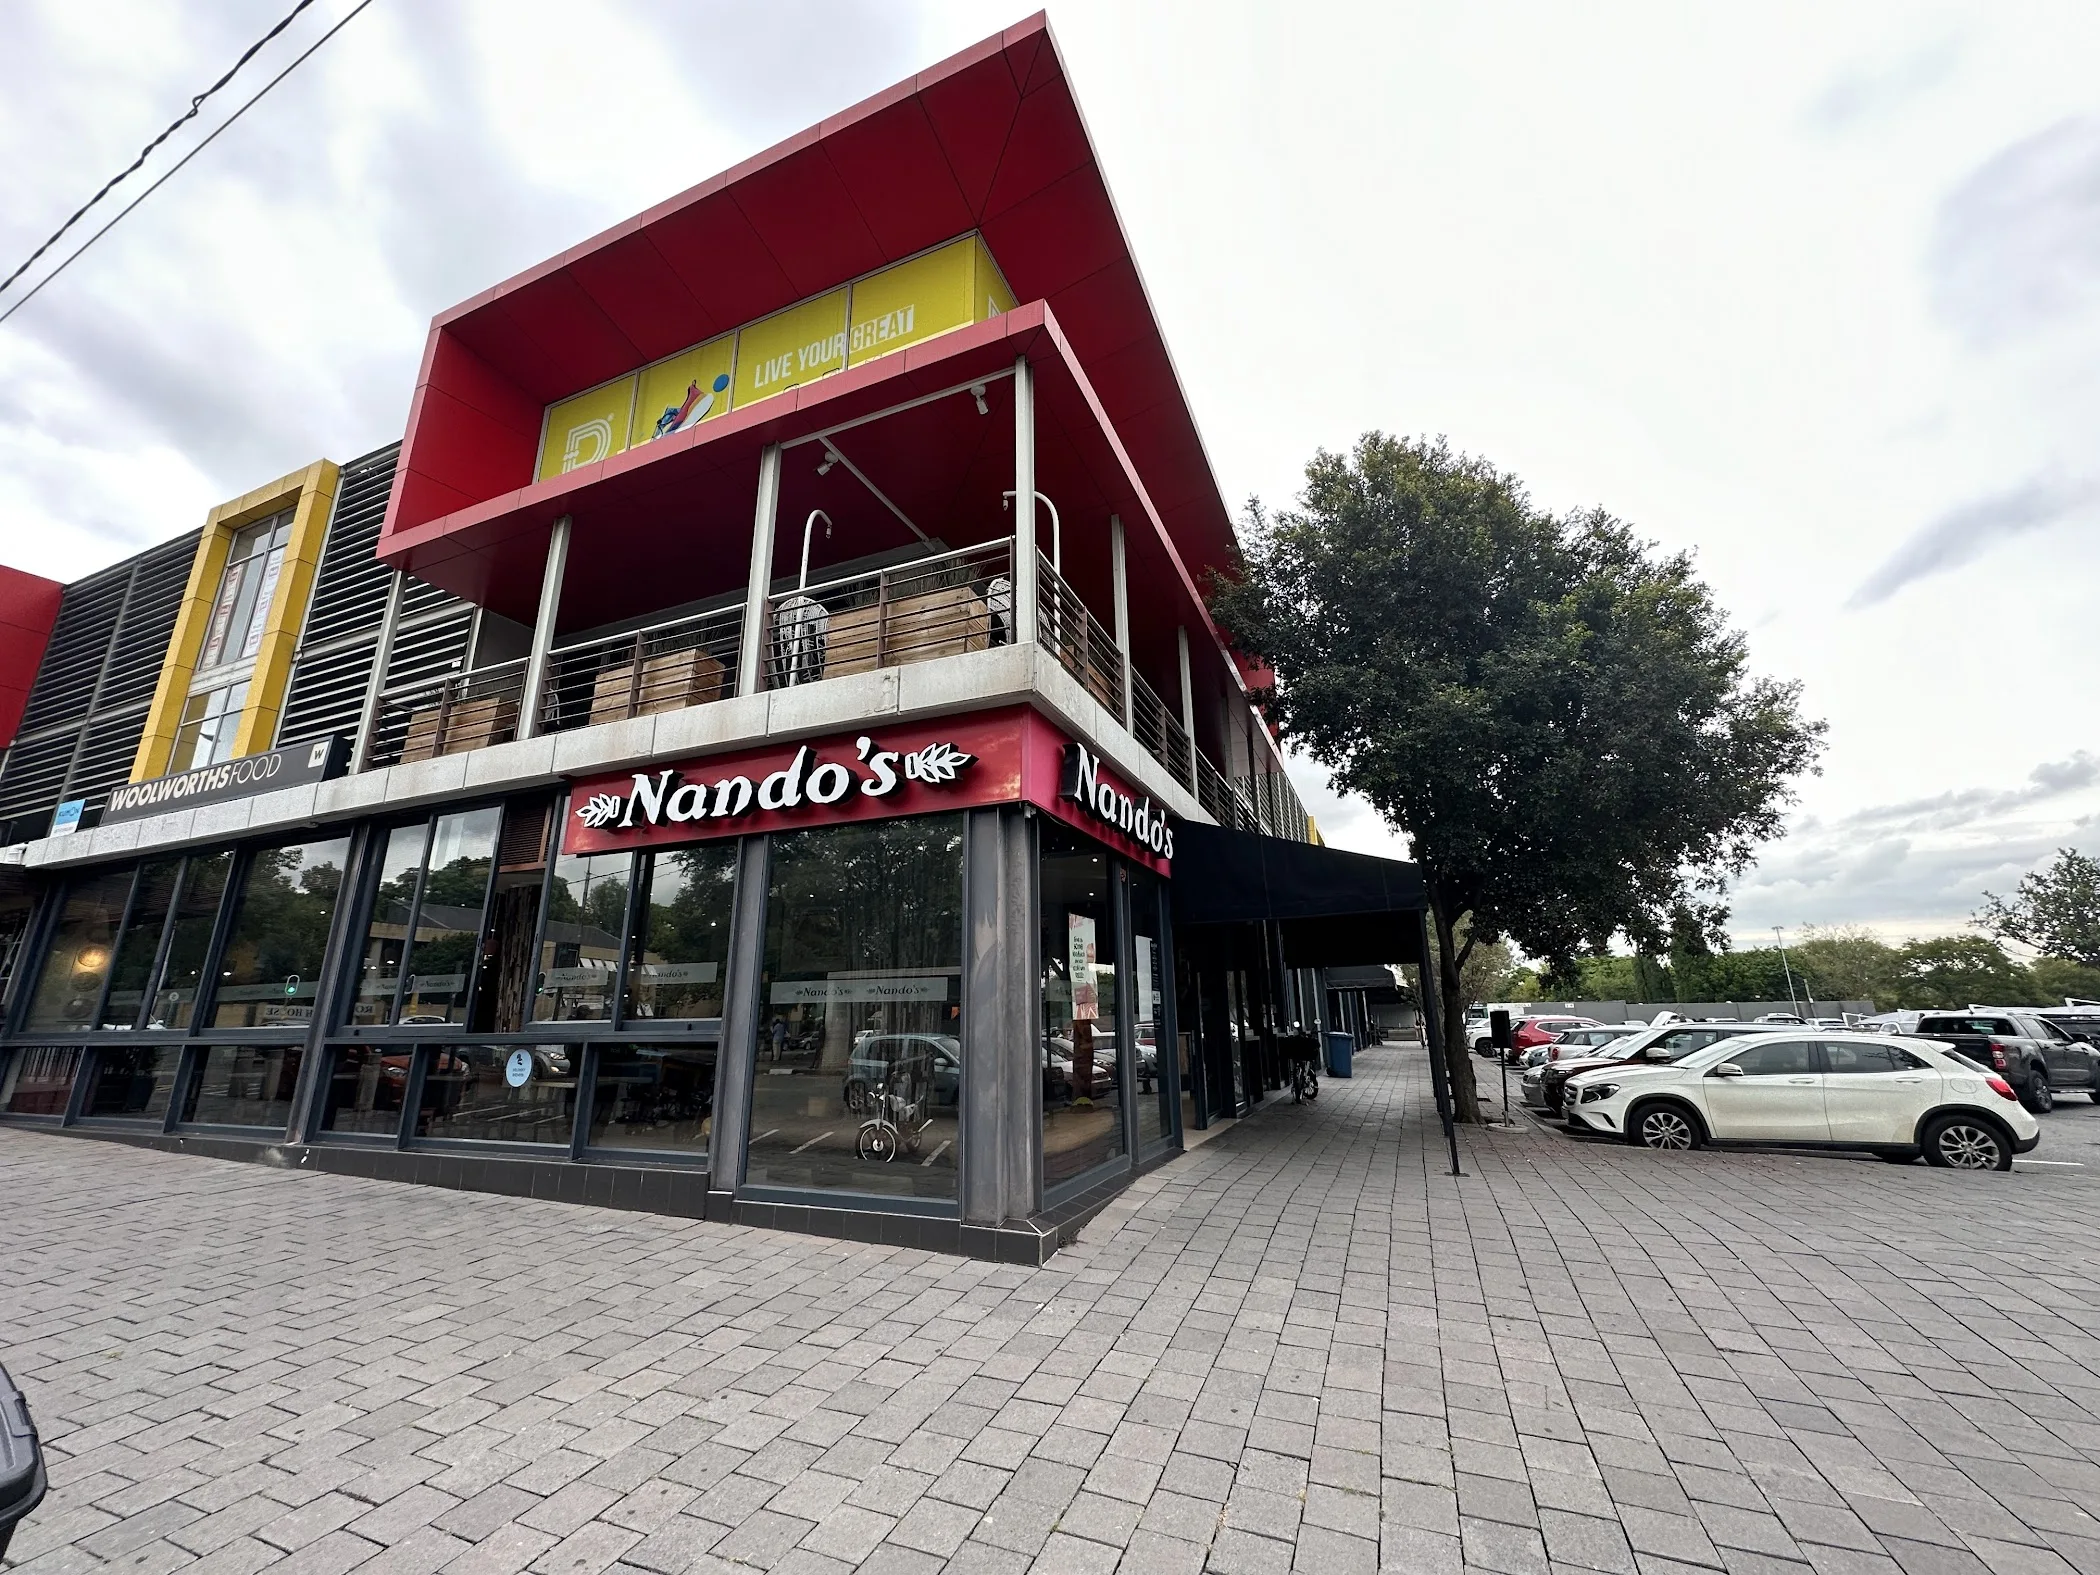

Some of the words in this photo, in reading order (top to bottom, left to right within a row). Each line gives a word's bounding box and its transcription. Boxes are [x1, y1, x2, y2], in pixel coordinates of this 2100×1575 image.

[754, 352, 793, 388] LIVE
[798, 332, 846, 371] YOUR
[852, 306, 913, 351] GREAT
[617, 736, 899, 827] Nando's
[1074, 742, 1173, 860] Nando's
[876, 985, 920, 995] Nando's
